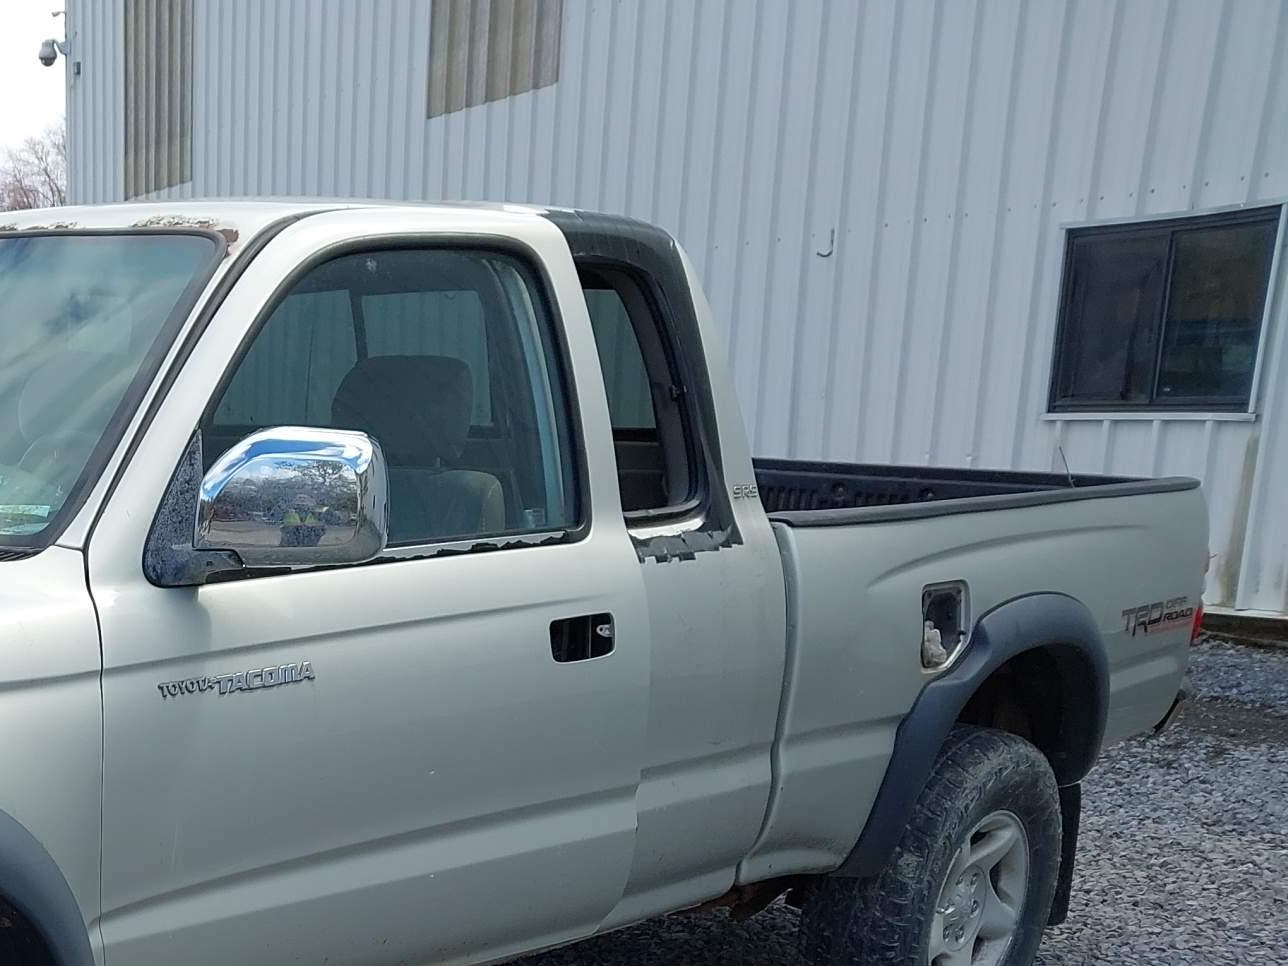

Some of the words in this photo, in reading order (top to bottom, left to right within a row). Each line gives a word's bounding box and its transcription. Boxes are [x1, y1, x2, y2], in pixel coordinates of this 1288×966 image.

[1122, 601, 1164, 637] TRD
[1163, 607, 1194, 622] ROAD
[158, 677, 214, 698] TOYOTA
[215, 661, 317, 695] TACOMA
